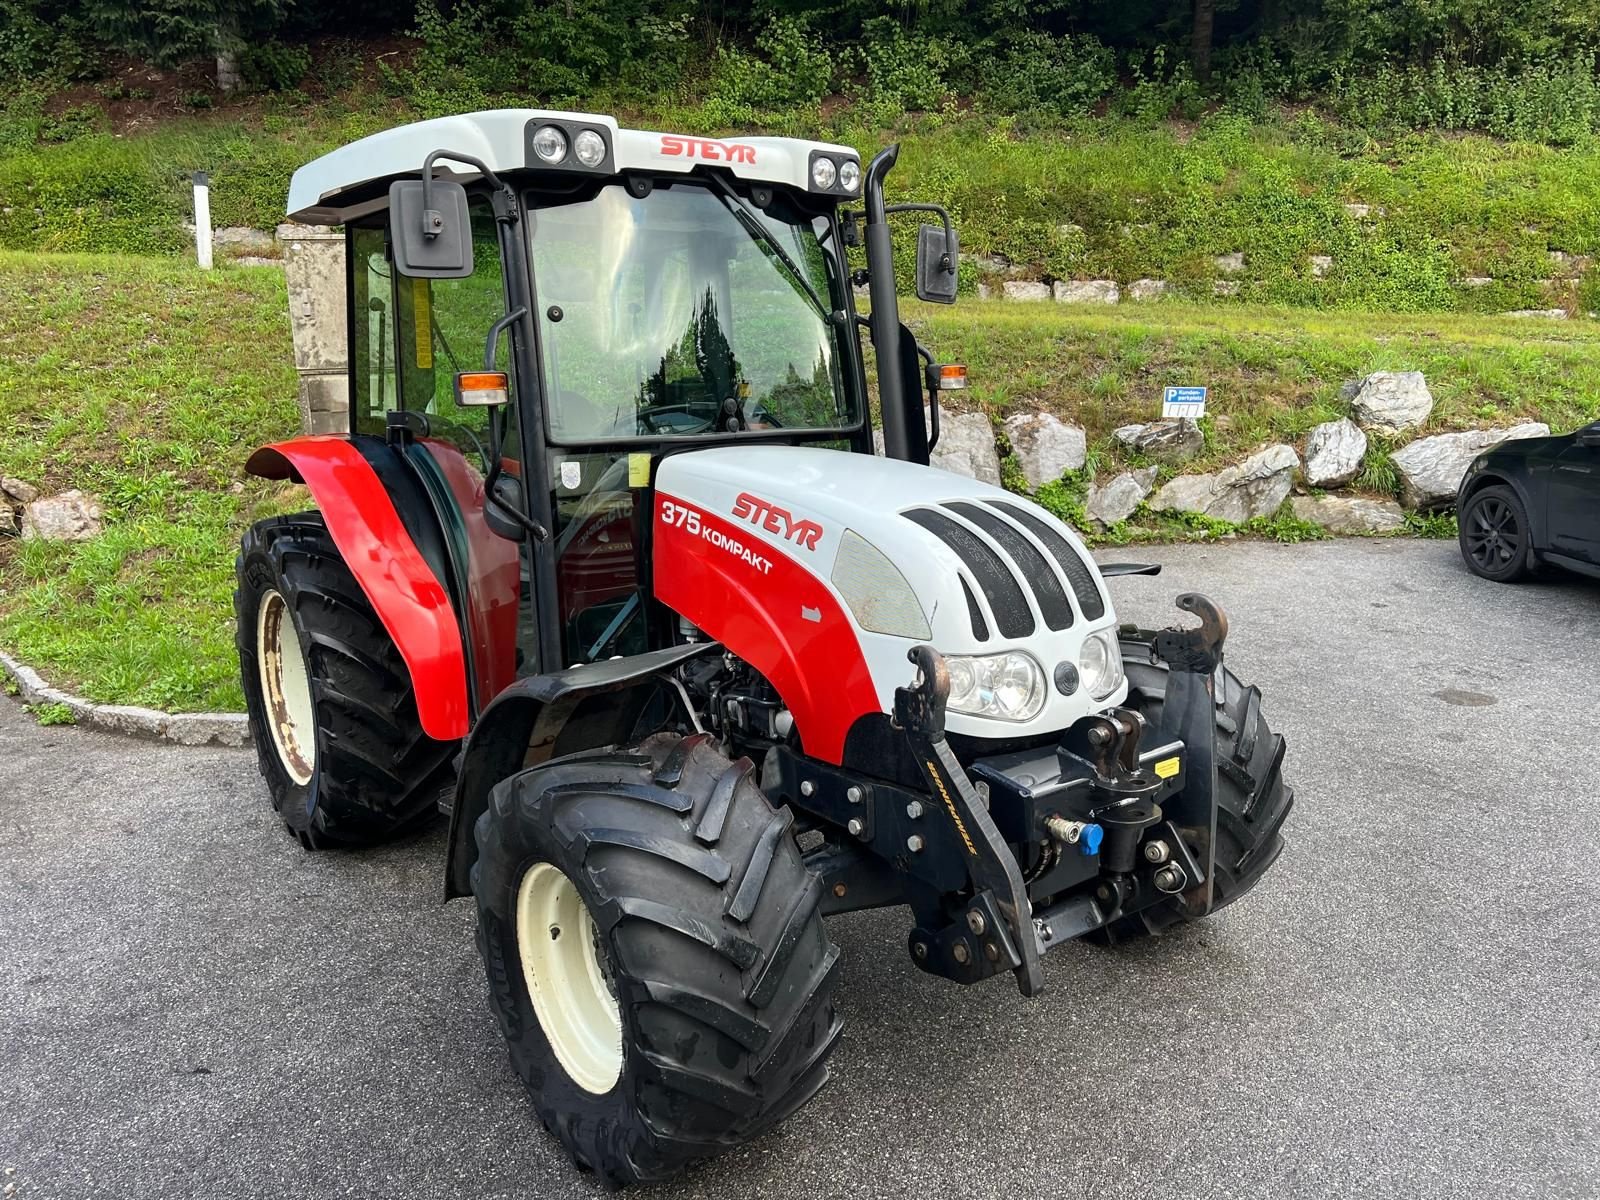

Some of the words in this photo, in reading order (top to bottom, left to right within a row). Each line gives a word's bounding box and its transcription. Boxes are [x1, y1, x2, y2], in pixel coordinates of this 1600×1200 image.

[661, 136, 756, 165] STEYR
[1168, 389, 1178, 401] P
[661, 501, 701, 535] 375
[701, 525, 773, 575] KOMPAKT
[731, 492, 824, 551] STEYR
